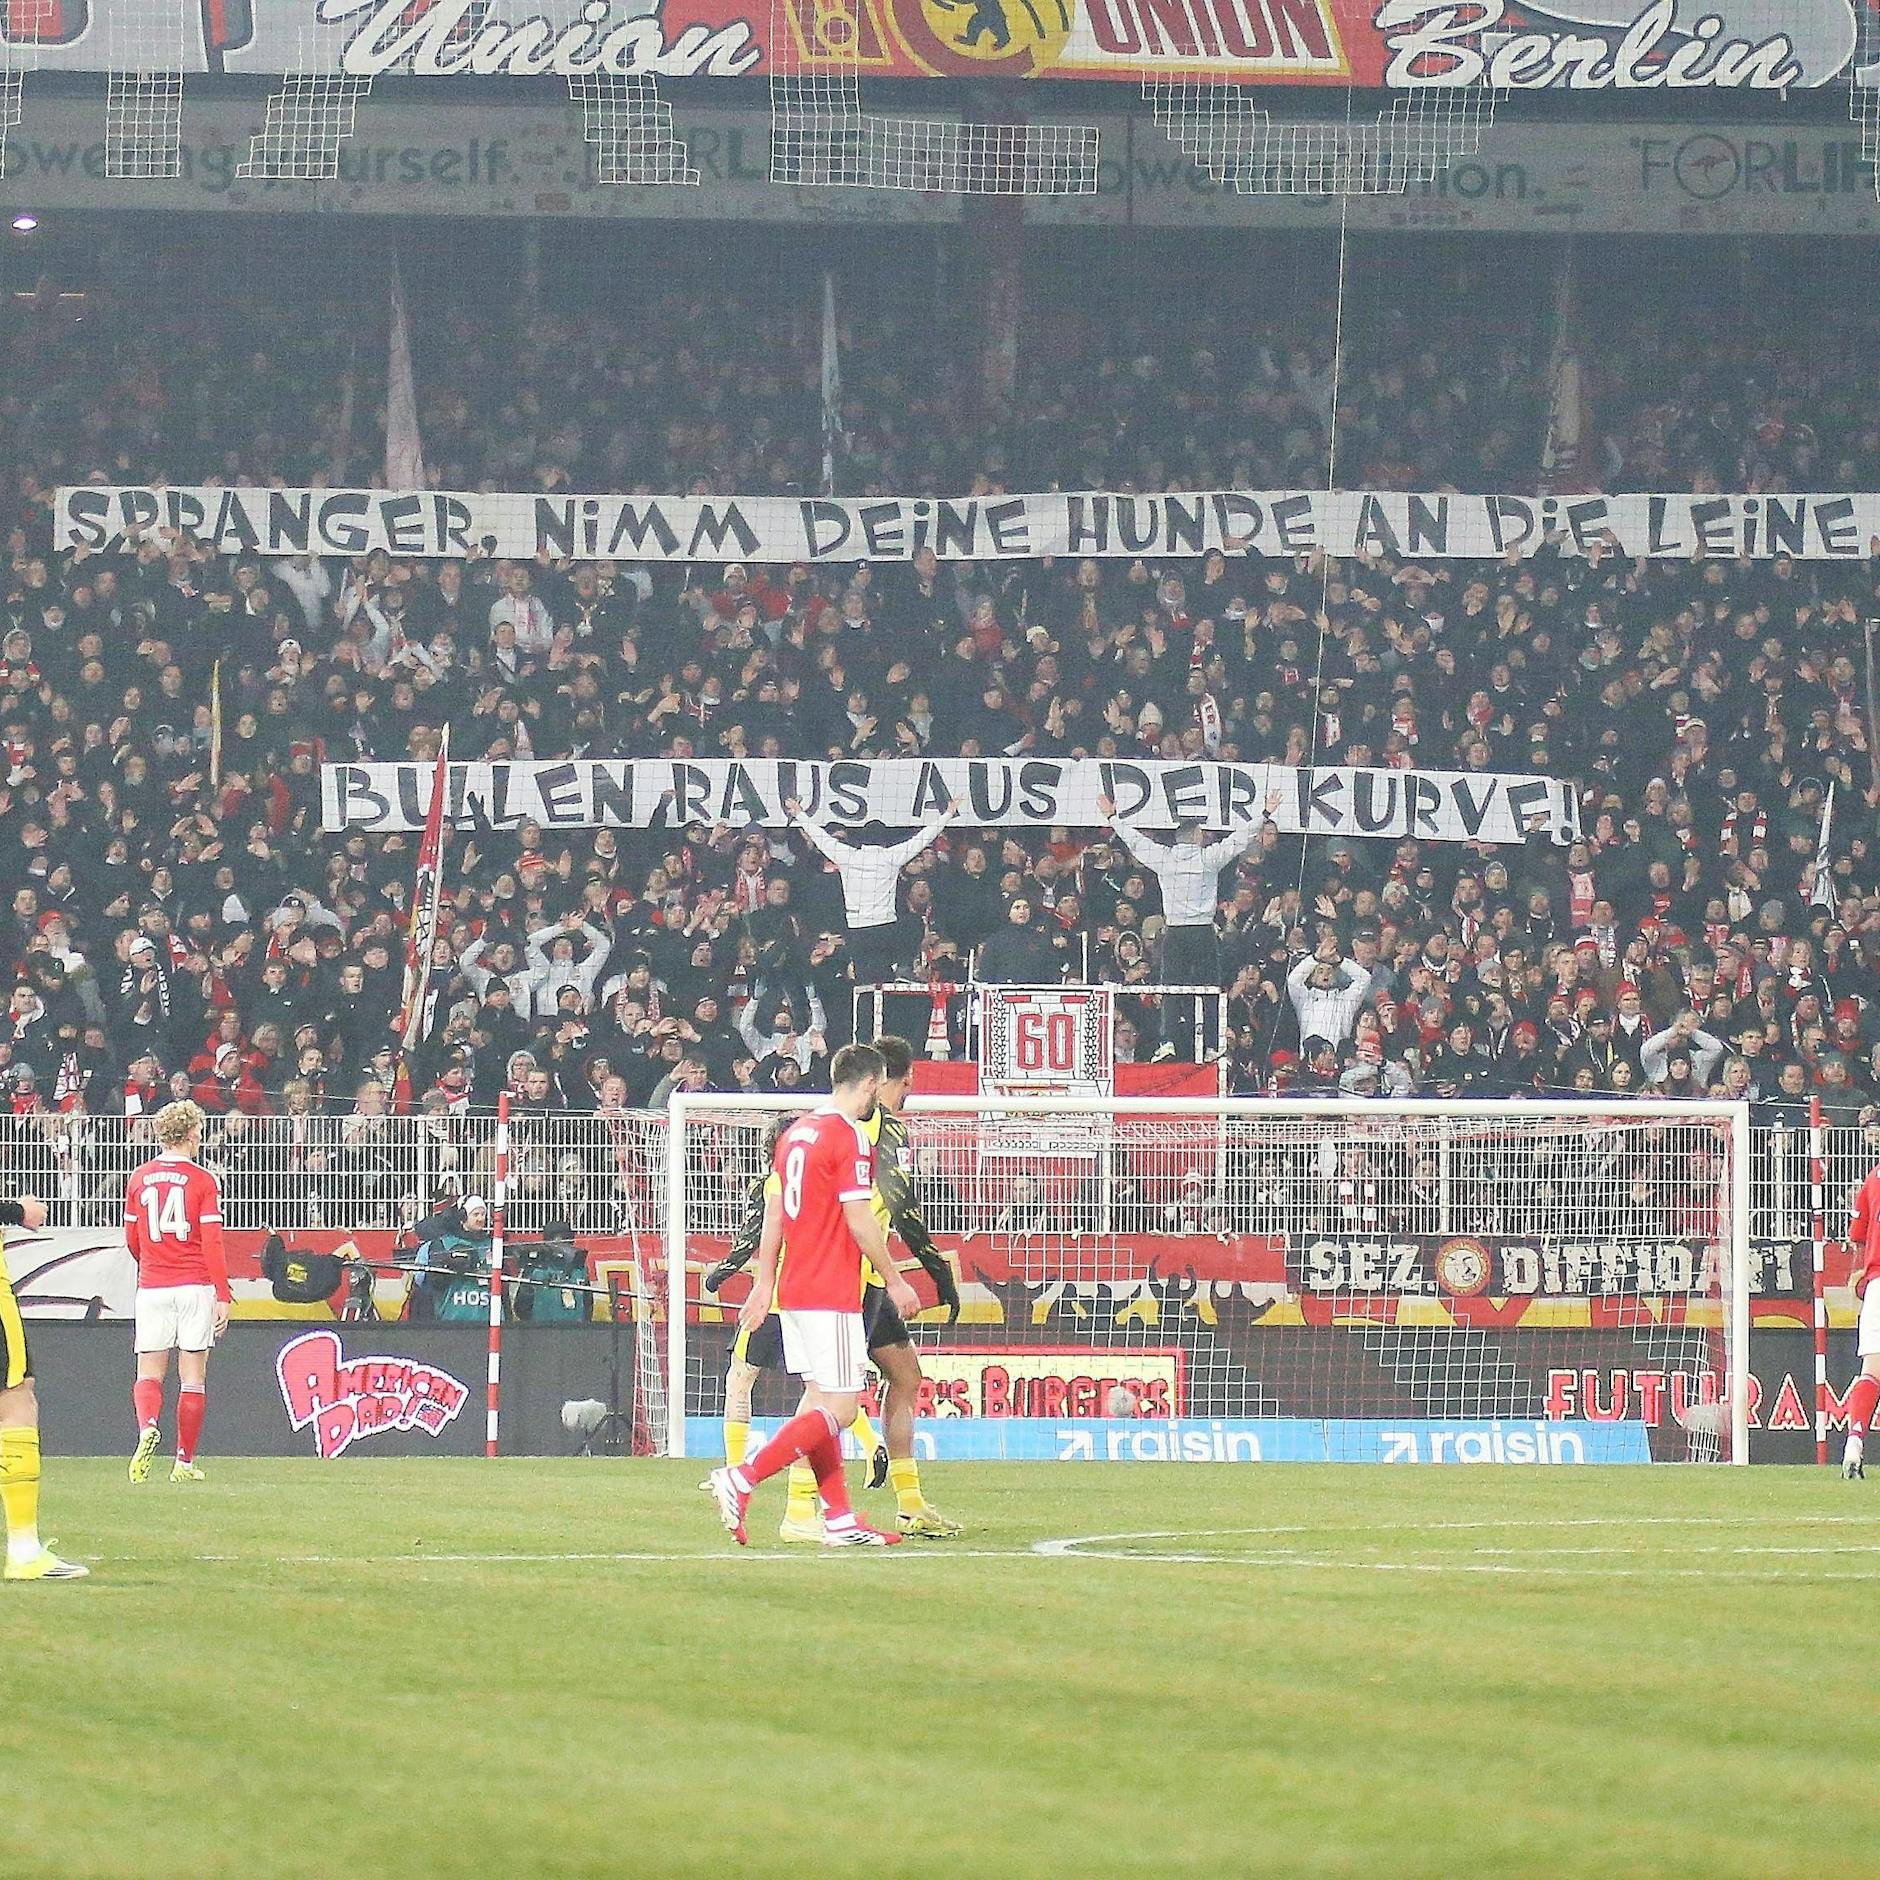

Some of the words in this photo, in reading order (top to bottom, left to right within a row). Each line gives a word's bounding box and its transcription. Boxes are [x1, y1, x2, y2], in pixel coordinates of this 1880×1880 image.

[1374, 0, 1803, 89] Berlin
[1066, 493, 1316, 555] HUNDE
[1354, 494, 1449, 554] AN
[335, 763, 635, 828] BULLEN
[672, 761, 873, 826] RAUS
[912, 761, 1063, 822] AUS
[1099, 762, 1257, 826] DER
[1298, 766, 1574, 842] KURVE!
[1017, 1013, 1074, 1071] 60
[783, 1145, 806, 1221] 8
[141, 1185, 192, 1243] 14
[1107, 1421, 1261, 1463] raisin
[1430, 1421, 1585, 1465] raisin
